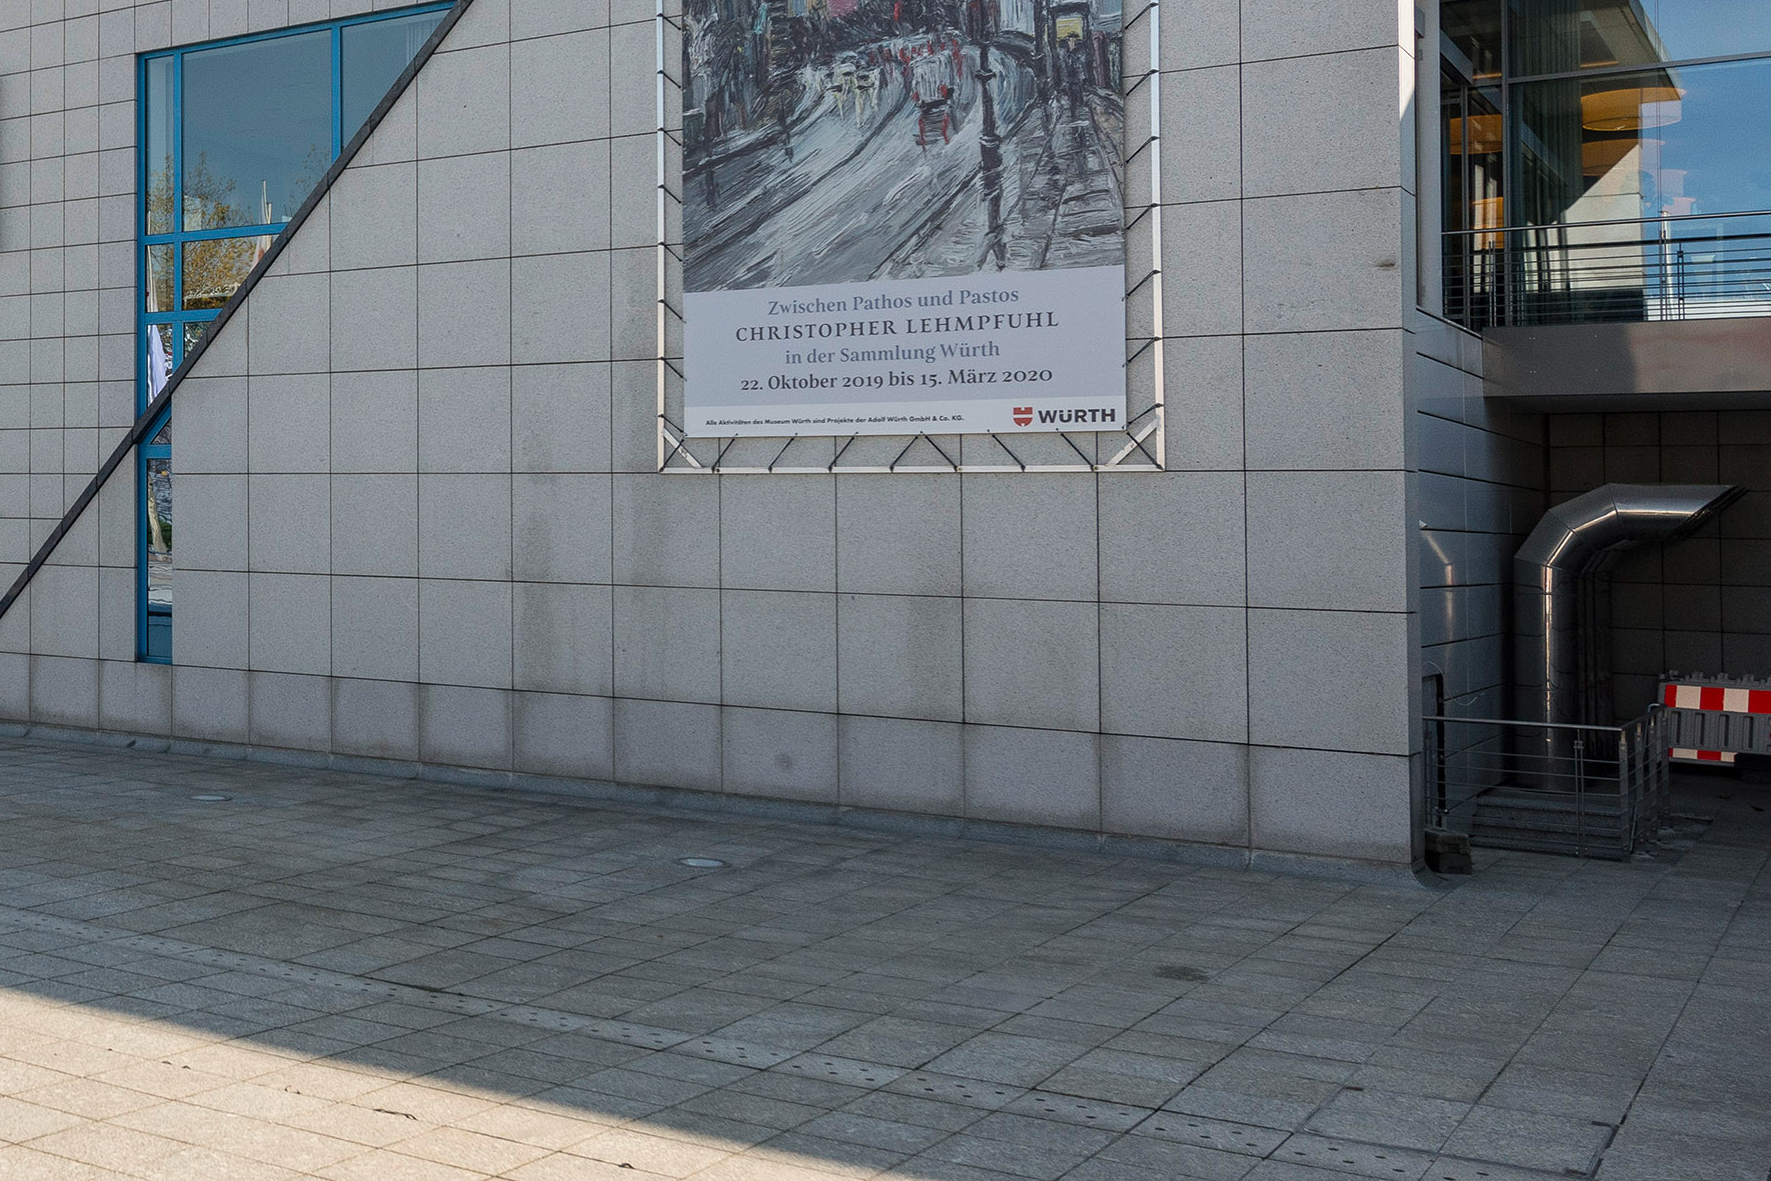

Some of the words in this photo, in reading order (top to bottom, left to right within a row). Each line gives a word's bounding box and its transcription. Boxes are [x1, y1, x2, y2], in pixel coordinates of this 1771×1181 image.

[768, 298, 847, 315] Zwischen
[852, 294, 912, 311] Pathos
[918, 290, 953, 307] und
[959, 289, 1019, 305] Pastos
[735, 319, 898, 342] CHRISTOPHER
[906, 311, 1059, 334] LEHMPFUHL
[785, 350, 802, 364] in
[807, 348, 835, 365] der
[840, 345, 936, 364] Sammlung
[940, 341, 1000, 358] Würth
[740, 379, 764, 391] 22.
[767, 373, 838, 390] Oktober
[842, 375, 884, 389] 2019
[888, 371, 915, 387] bis
[920, 374, 943, 388] 15.
[947, 369, 997, 385] März
[1002, 369, 1053, 383] 2020
[827, 417, 854, 425] Projekte
[1038, 408, 1116, 424] WÜRTH
